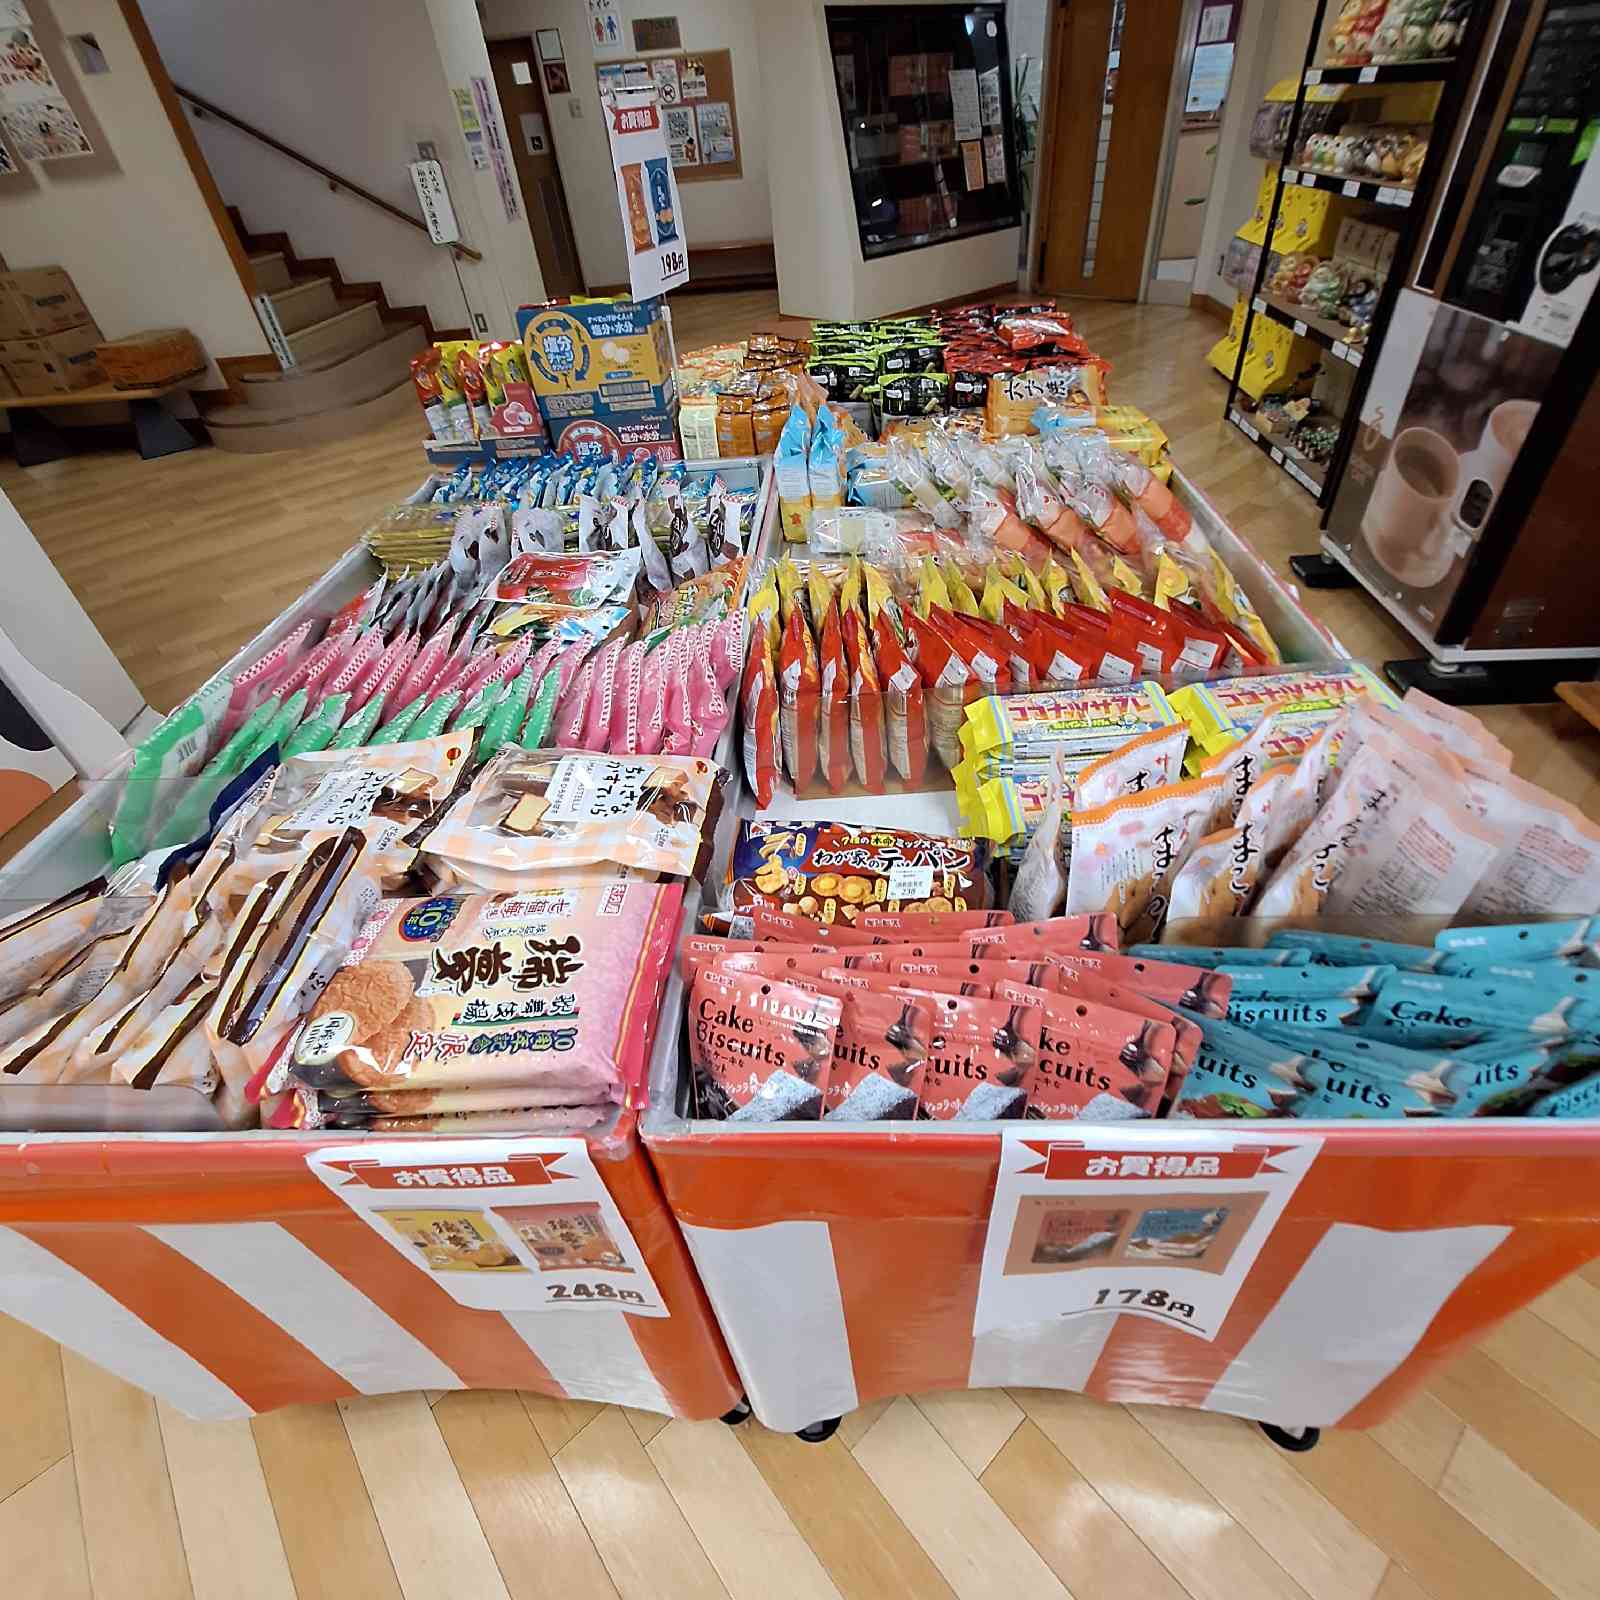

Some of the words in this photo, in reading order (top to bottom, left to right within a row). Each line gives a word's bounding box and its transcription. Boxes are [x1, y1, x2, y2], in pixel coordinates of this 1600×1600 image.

[621, 110, 653, 129] お買得品
[661, 253, 684, 272] 198円
[1004, 379, 1068, 401] 六方焼
[1218, 680, 1367, 709] ココナッツサブレ
[1008, 697, 1152, 721] ココナッツサブレ
[590, 760, 622, 818] かすていら
[611, 766, 645, 816] ちいさな
[814, 847, 970, 874] わが家のテッパン
[433, 935, 584, 994] 瑞夢
[699, 998, 754, 1033] Cake
[1391, 1001, 1473, 1029] Cake
[697, 1019, 786, 1067] Biscuits
[1039, 1027, 1071, 1056] ke
[834, 1043, 881, 1070] uits
[934, 1054, 987, 1080] uits
[1039, 1058, 1110, 1091] cuits
[1198, 1054, 1258, 1089] uits
[1326, 1077, 1392, 1109] uits
[393, 1166, 515, 1187] お買得品
[1086, 1156, 1221, 1177] お買得品
[547, 1283, 646, 1302] 248円
[1095, 1288, 1196, 1318] 178円
